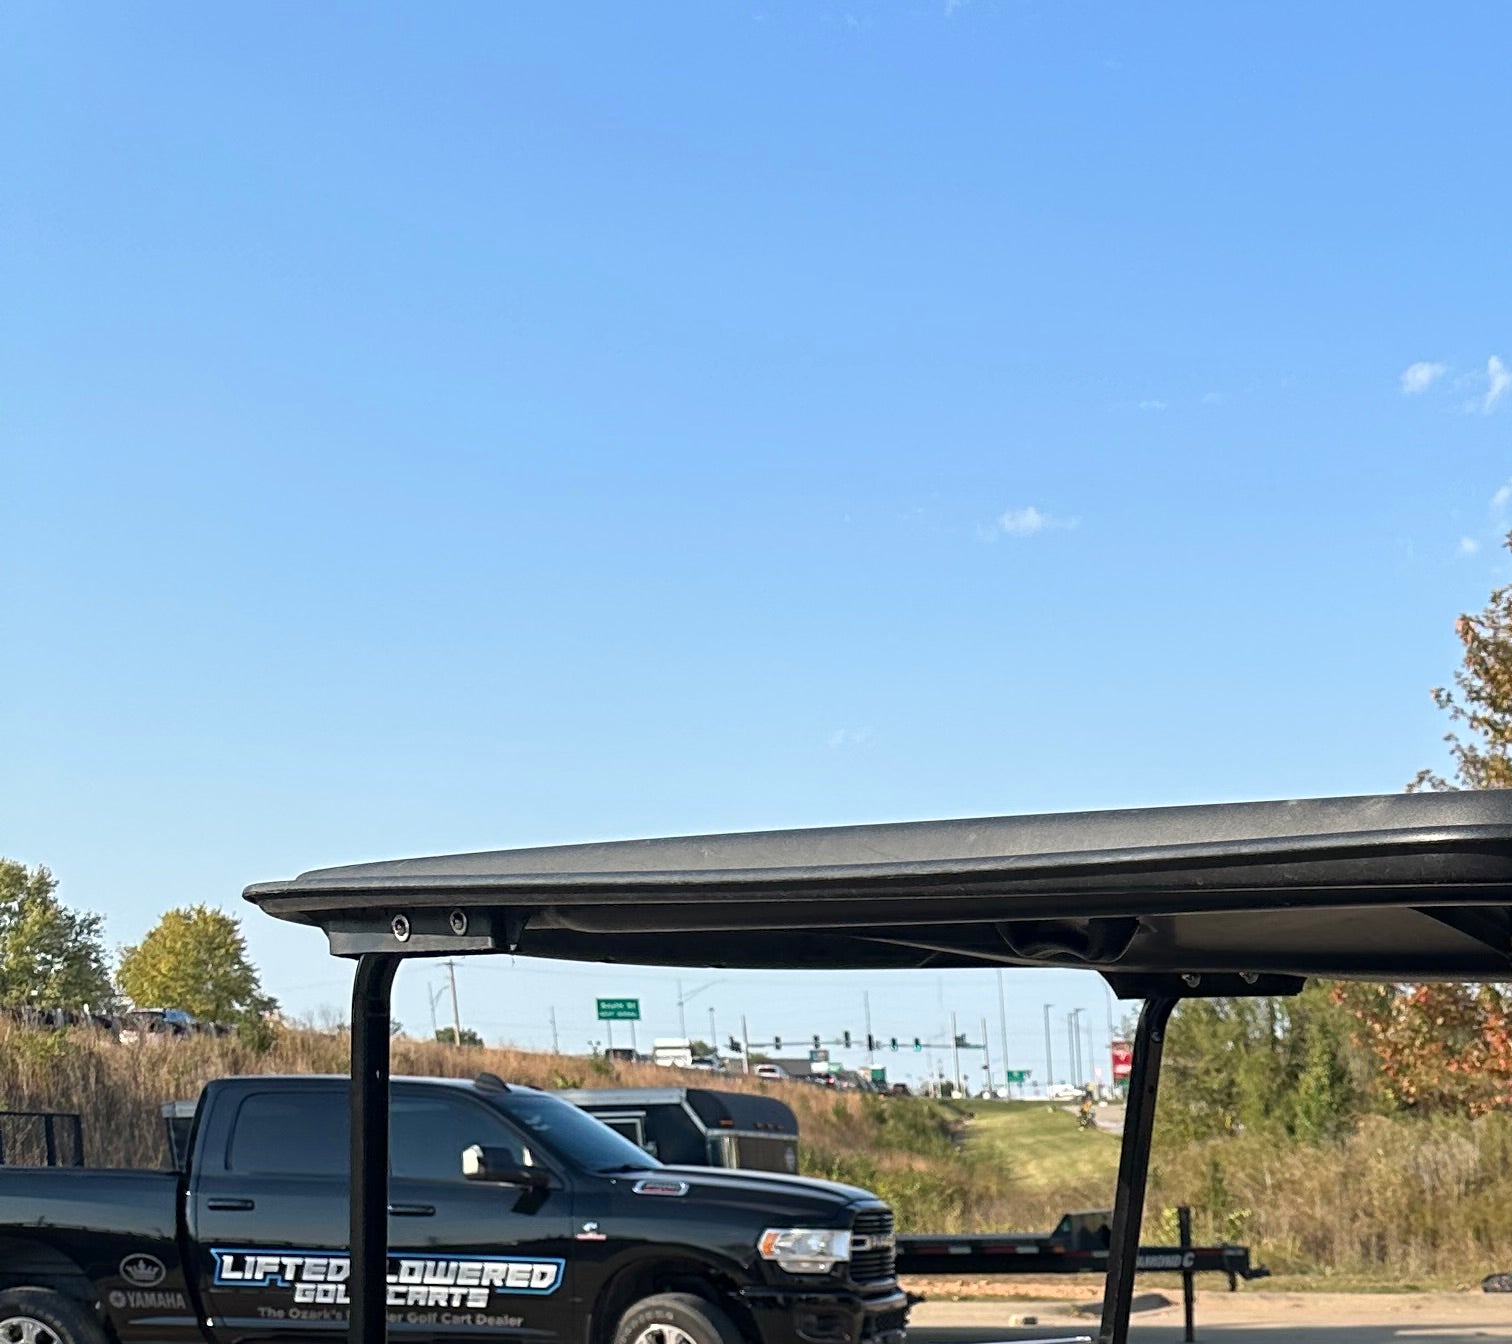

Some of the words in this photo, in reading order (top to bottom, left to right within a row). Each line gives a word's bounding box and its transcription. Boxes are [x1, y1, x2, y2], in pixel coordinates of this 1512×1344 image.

[220, 1255, 350, 1281] LIFTED
[126, 1290, 186, 1309] YAMAHA
[294, 1282, 350, 1304] GOL
[386, 1286, 490, 1308] CARTS
[257, 1306, 286, 1318] The
[288, 1307, 342, 1319] Ozark's
[407, 1312, 438, 1324] Golf
[441, 1313, 472, 1325] Cart
[475, 1314, 524, 1327] Dealer
